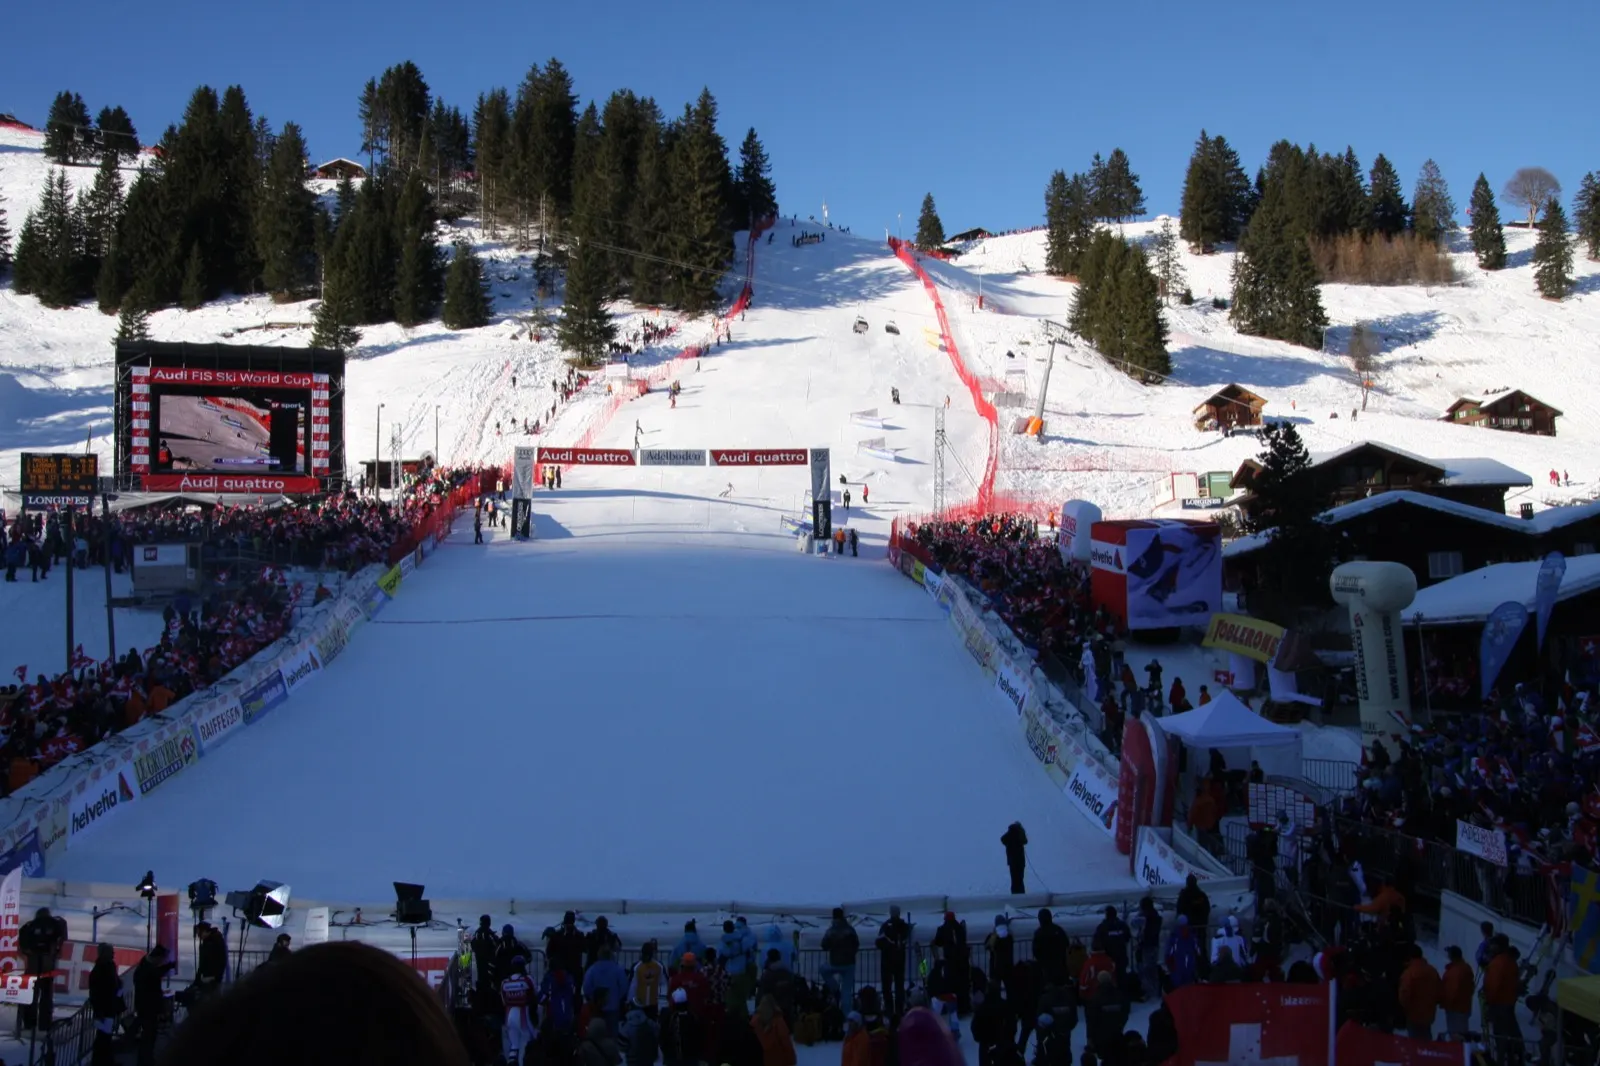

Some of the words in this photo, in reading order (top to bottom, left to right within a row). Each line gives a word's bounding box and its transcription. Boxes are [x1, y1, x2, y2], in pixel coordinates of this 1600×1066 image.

[154, 369, 188, 380] Audi
[191, 371, 213, 381] FIS
[216, 371, 236, 382] Ski
[240, 373, 280, 384] World
[283, 374, 311, 386] Cup
[541, 447, 574, 463] Audi
[577, 449, 629, 466] quattro
[646, 449, 701, 462] Adelboden
[718, 449, 751, 463] Audi
[755, 449, 805, 466] quattro
[181, 477, 218, 488] Audi
[223, 477, 285, 491] quattro
[28, 495, 89, 505] LONGINES
[287, 661, 311, 688] helvetia
[998, 671, 1020, 705] helvetia
[199, 704, 241, 742] RAIFFEISEN
[1070, 773, 1104, 816] helvetia
[72, 788, 118, 834] helvetia
